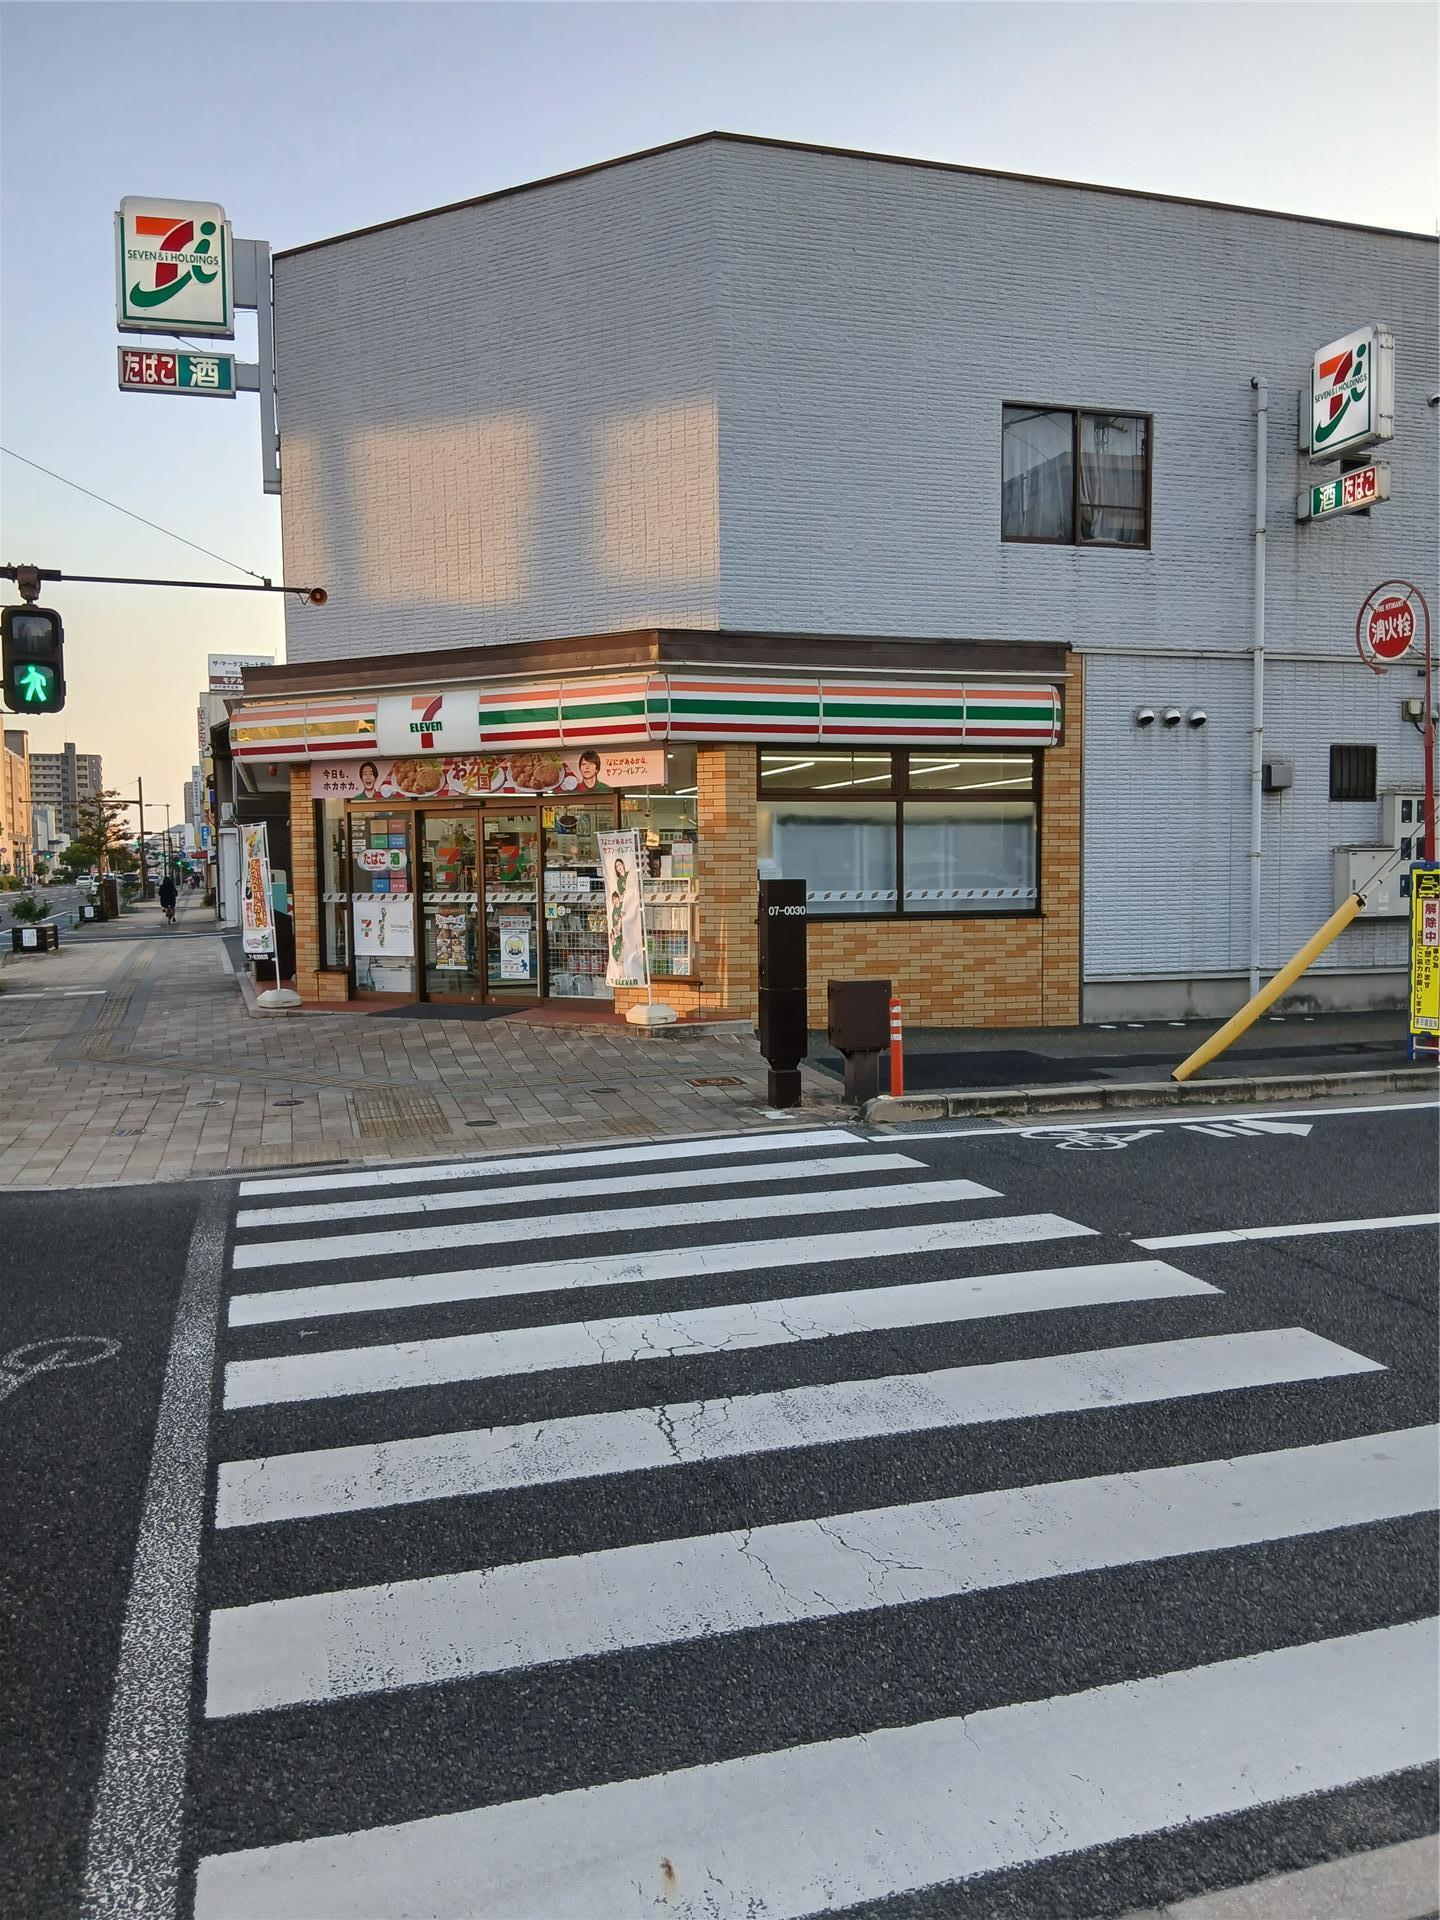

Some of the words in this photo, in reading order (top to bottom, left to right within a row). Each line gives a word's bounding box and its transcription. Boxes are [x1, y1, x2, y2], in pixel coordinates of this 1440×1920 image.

[171, 252, 219, 266] HOLDINGS
[124, 353, 175, 384] たばこ
[189, 356, 219, 388] 酒
[1338, 373, 1368, 392] HOLDINGS
[1319, 482, 1337, 513] 酒
[1344, 470, 1375, 503] たばこ
[1371, 612, 1412, 644] 消火栓
[198, 710, 207, 748] SHARP
[322, 769, 349, 779] 今日も、
[323, 782, 359, 791] ホカホカ。
[363, 852, 386, 865] たばこ
[768, 905, 806, 916] 07-0030
[1425, 903, 1437, 942] 解除中
